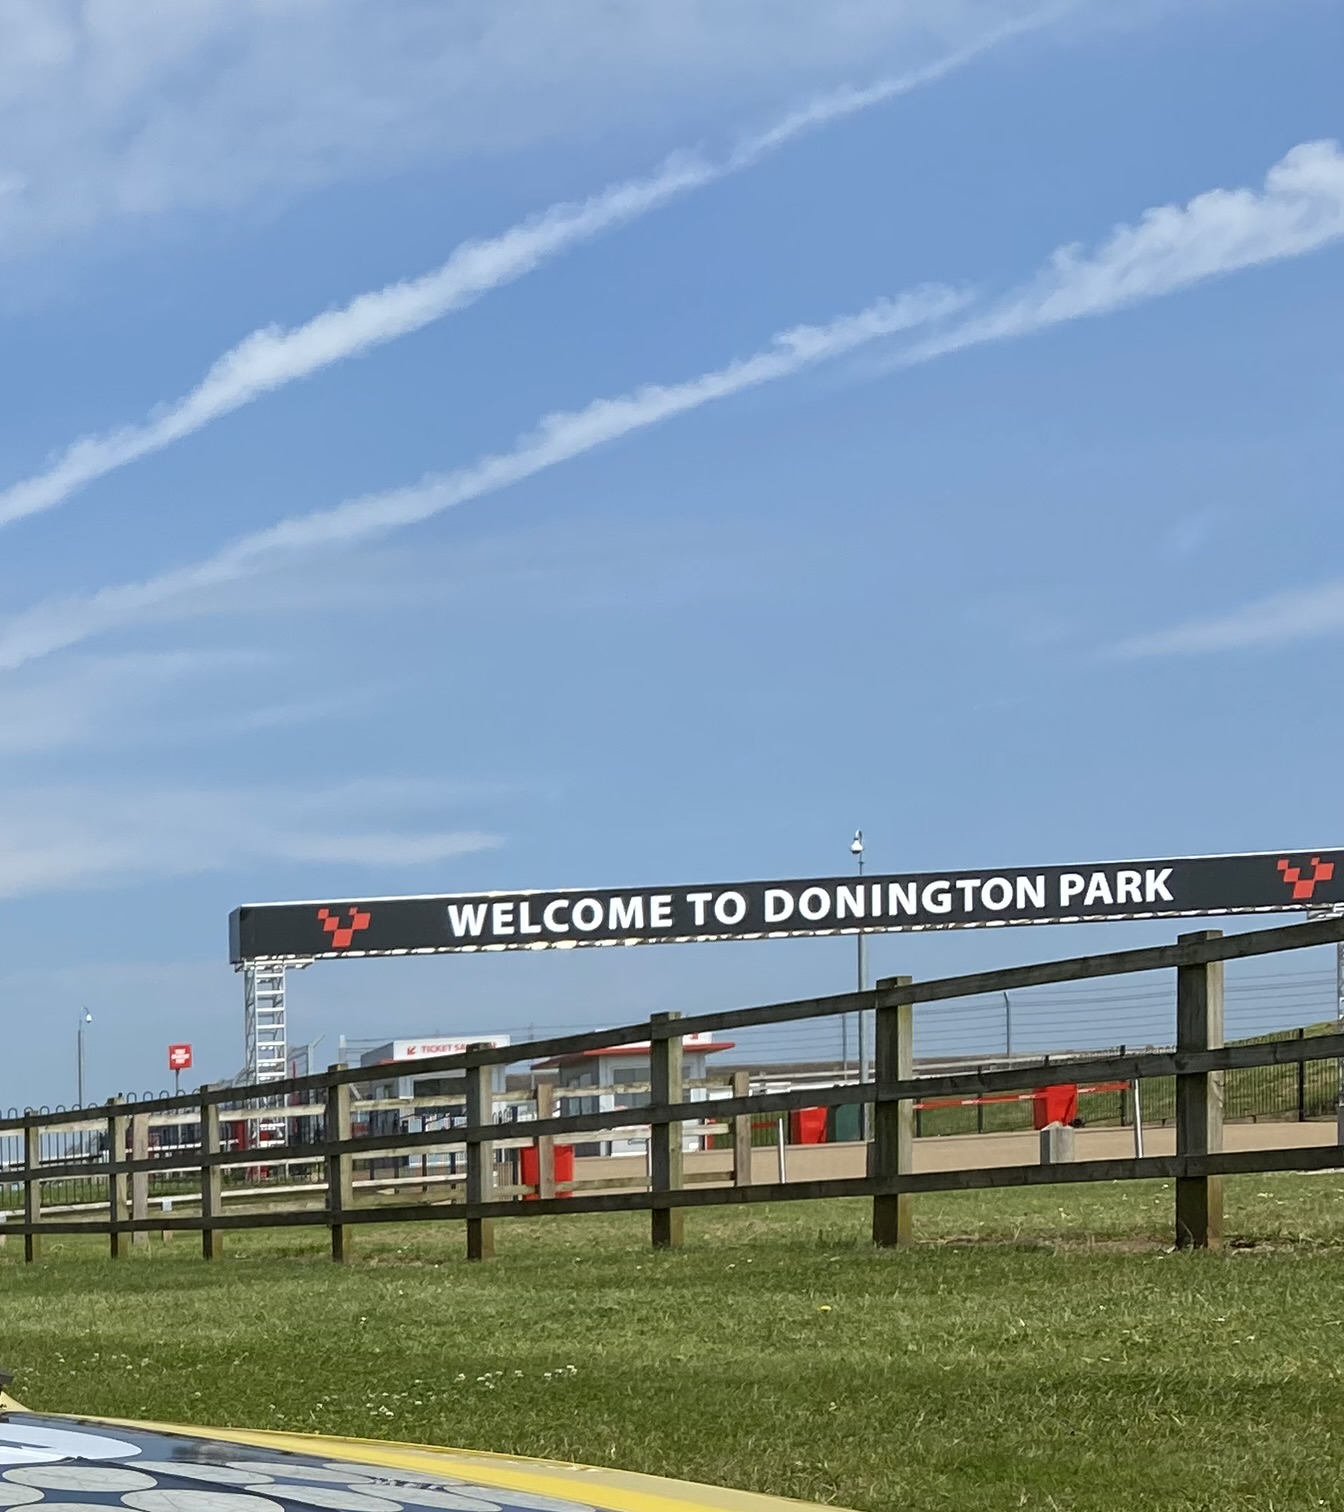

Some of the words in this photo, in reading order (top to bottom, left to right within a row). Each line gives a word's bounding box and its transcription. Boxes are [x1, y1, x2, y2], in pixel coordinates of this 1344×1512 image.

[447, 894, 674, 937] WELCOME
[686, 890, 747, 927] TO
[764, 874, 1046, 923] DONINGTON
[1060, 867, 1175, 907] PARK
[421, 1043, 453, 1054] TICKET
